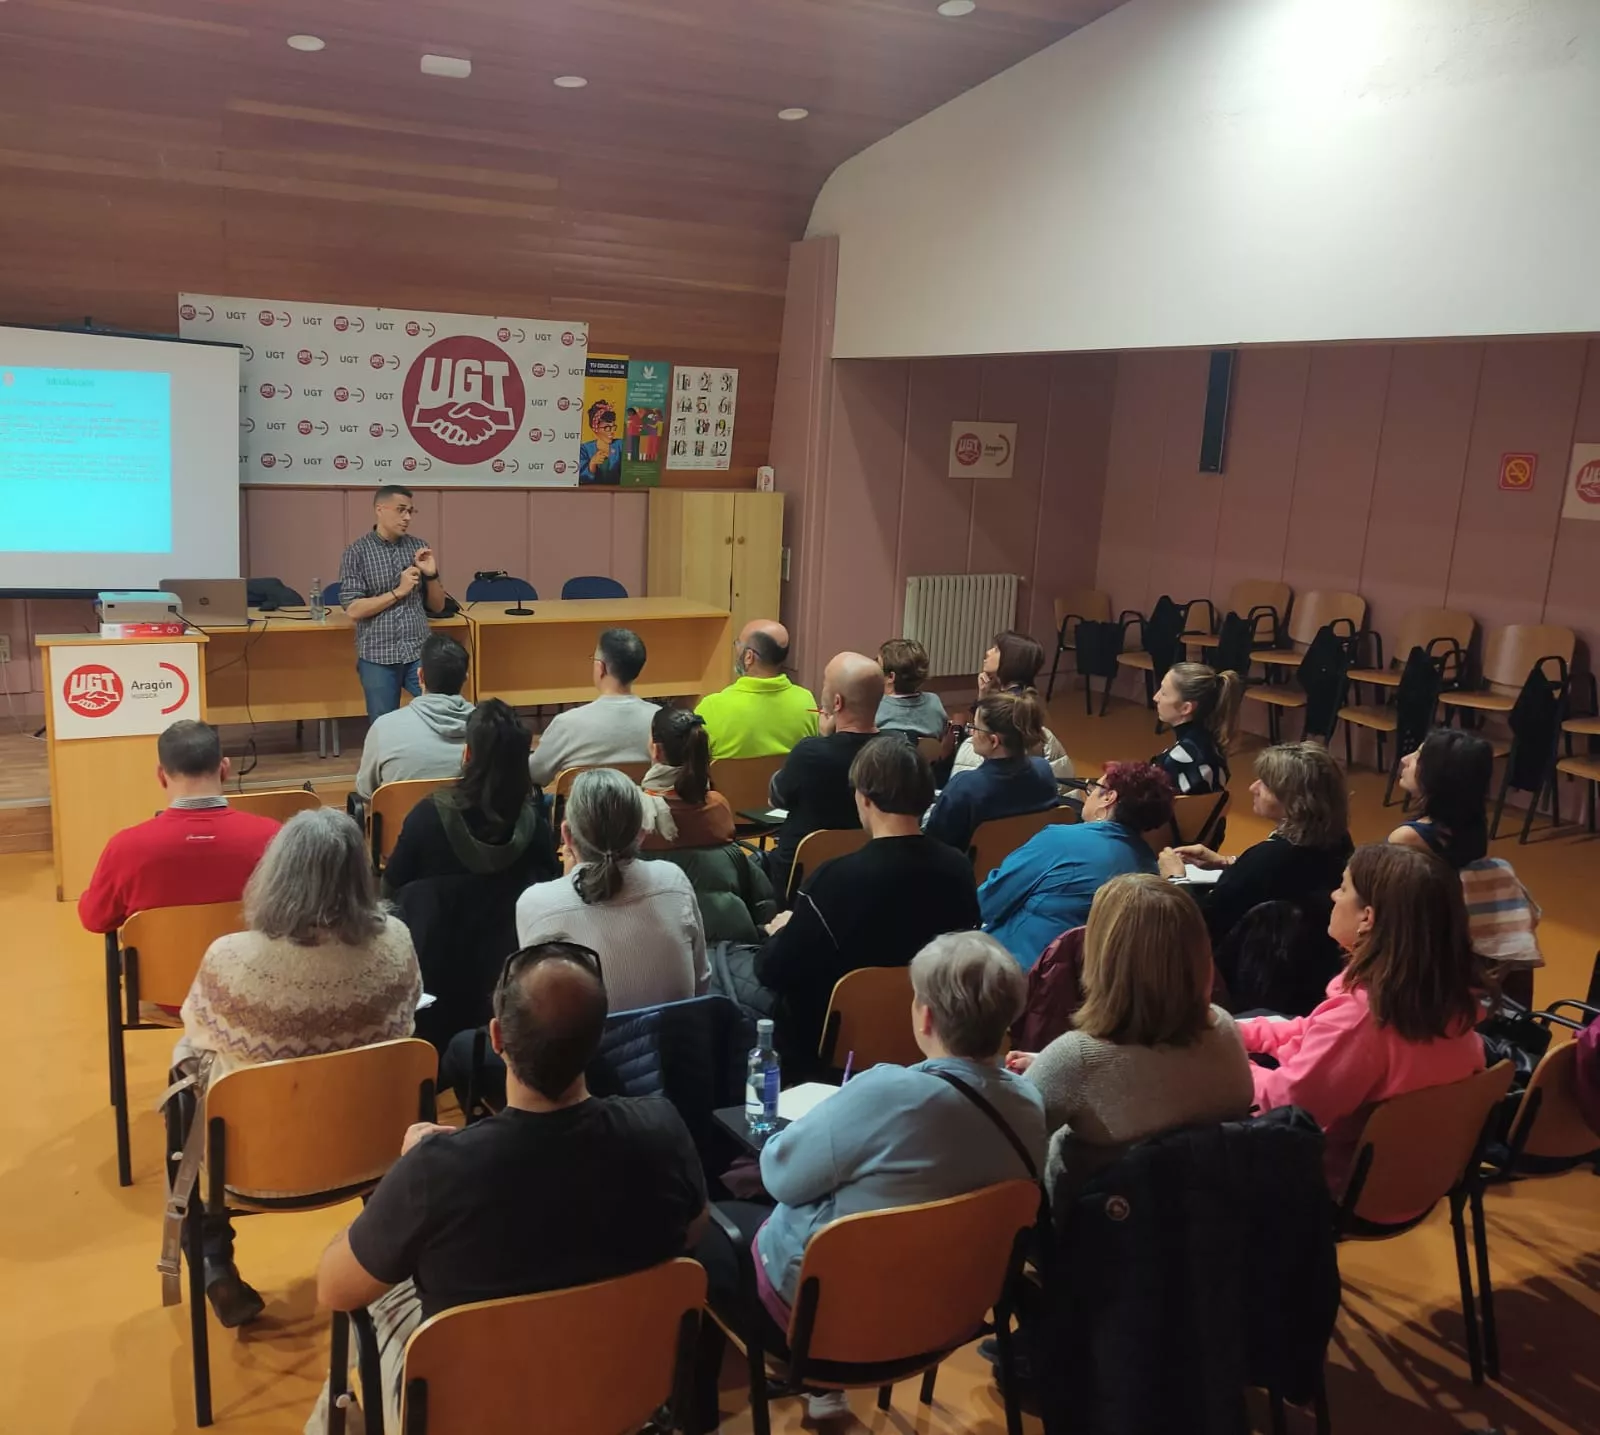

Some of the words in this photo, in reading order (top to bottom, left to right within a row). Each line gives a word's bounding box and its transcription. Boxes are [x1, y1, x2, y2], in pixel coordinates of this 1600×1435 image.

[226, 311, 247, 320] UGT
[302, 316, 322, 326] UGT
[375, 322, 395, 331] UGT
[534, 333, 552, 342] UGT
[265, 351, 285, 360] UGT
[340, 355, 360, 364] UGT
[568, 368, 584, 376] UGT
[417, 357, 510, 409] UGT
[304, 388, 322, 397] UGT
[375, 392, 394, 400] UGT
[531, 399, 548, 407] UGT
[266, 422, 286, 430] UGT
[340, 424, 360, 433] UGT
[564, 432, 580, 440] UGT
[304, 457, 322, 465] UGT
[374, 459, 393, 468] UGT
[528, 462, 545, 471] UGT
[71, 673, 116, 693] UGT
[131, 680, 172, 692] Aragón
